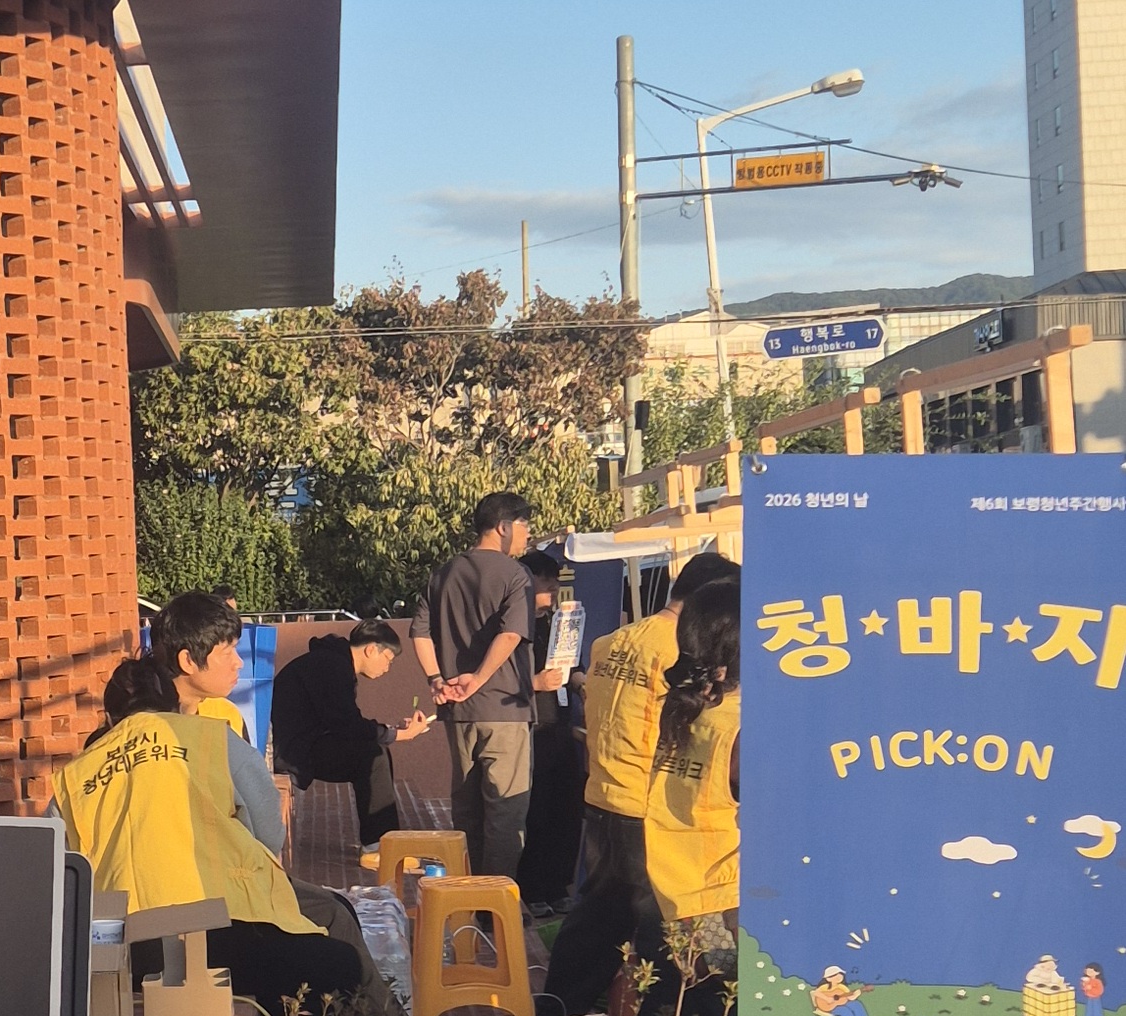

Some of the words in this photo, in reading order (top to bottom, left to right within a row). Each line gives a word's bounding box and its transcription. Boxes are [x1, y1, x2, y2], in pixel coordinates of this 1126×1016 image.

[800, 324, 845, 342] 행복로
[866, 328, 879, 339] 17
[769, 338, 781, 349] 13
[792, 341, 856, 355] Haengbok-ro
[764, 493, 802, 507] 2026
[805, 492, 849, 508] 청년의
[853, 491, 870, 508] 날
[970, 496, 1008, 511] 제6회
[106, 732, 158, 763] 보령시
[830, 729, 1055, 780] PICK:ON
[83, 745, 189, 794] 청년네트워크
